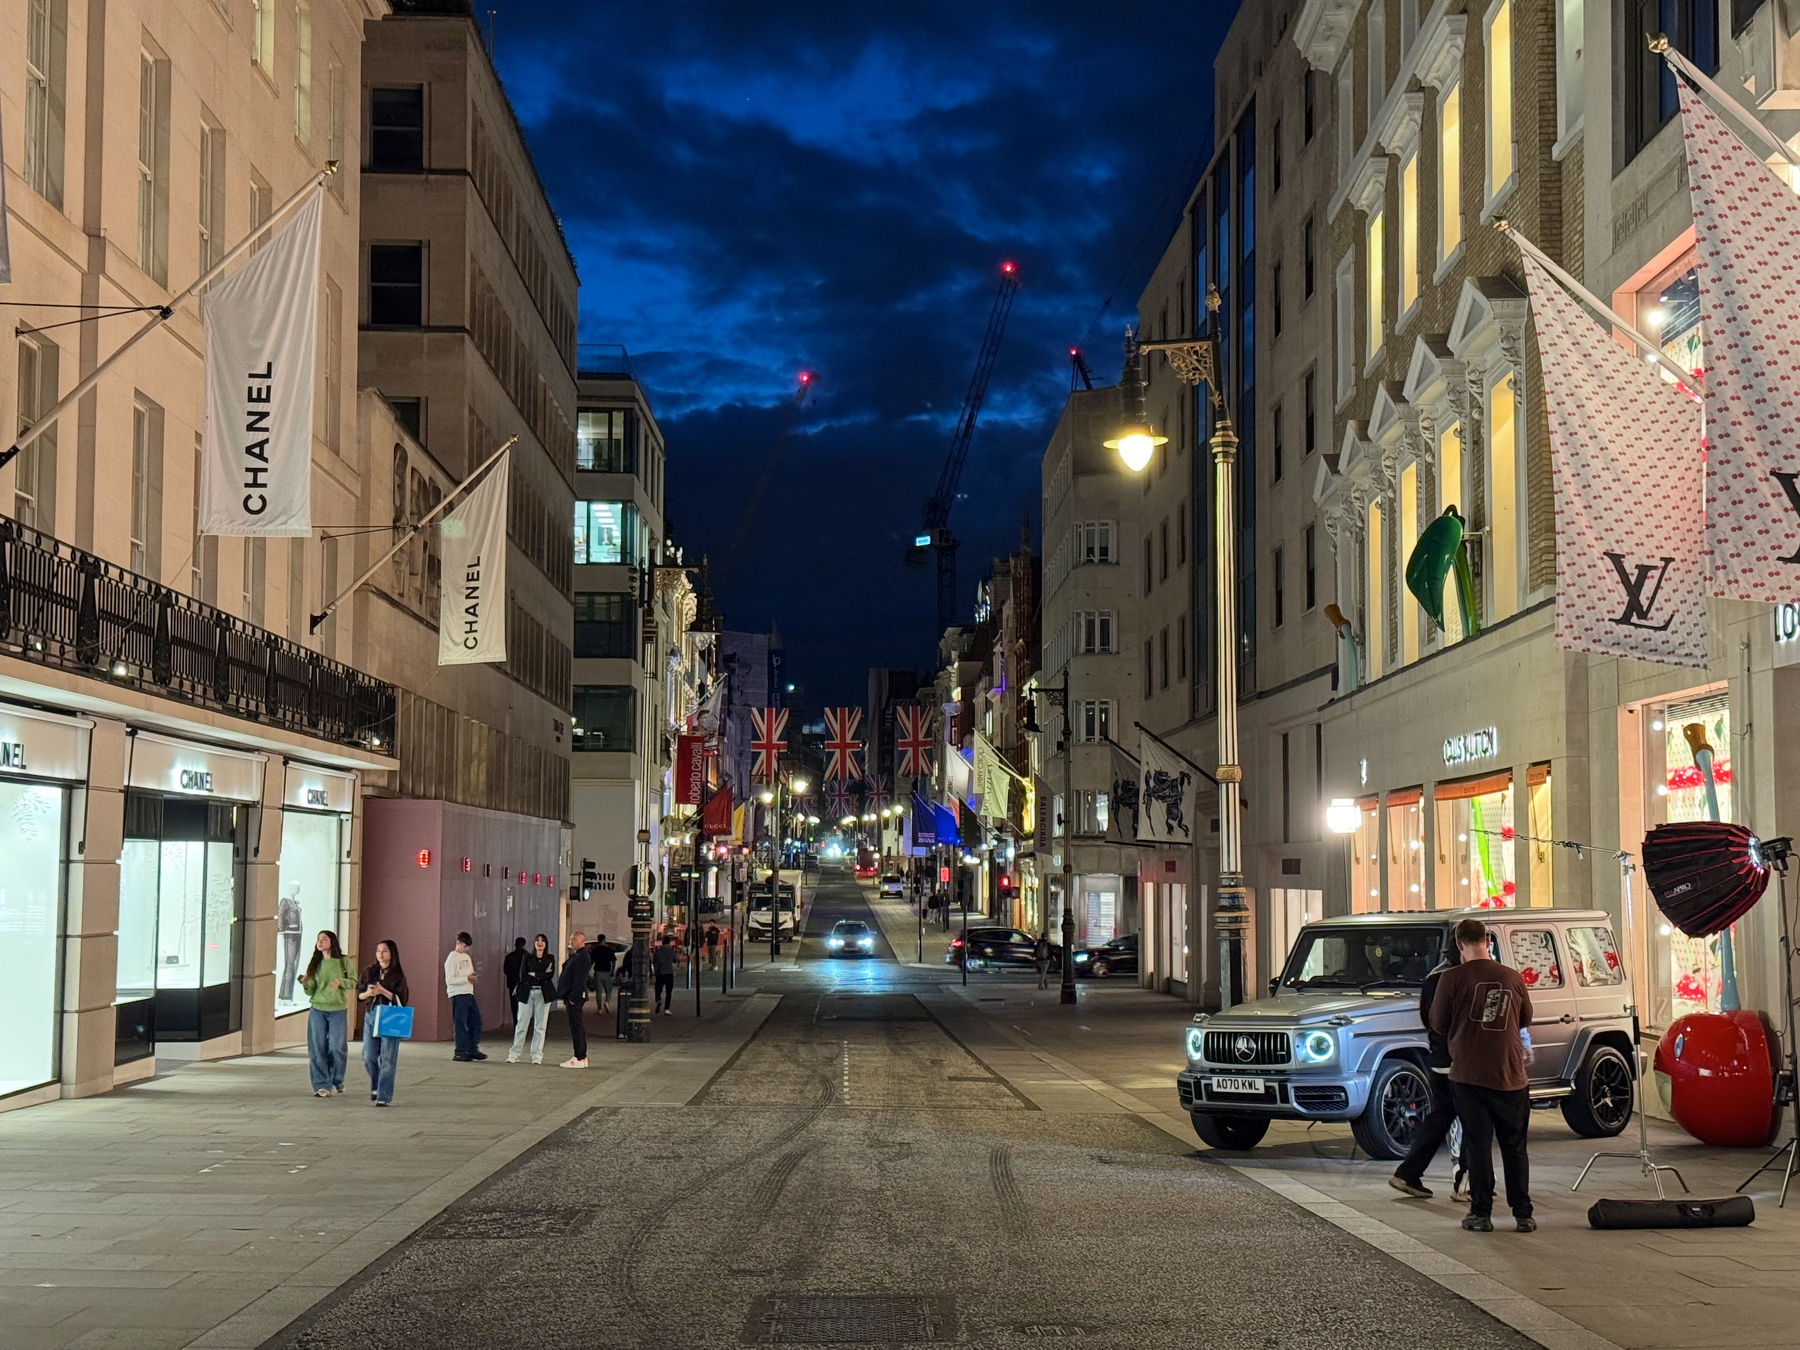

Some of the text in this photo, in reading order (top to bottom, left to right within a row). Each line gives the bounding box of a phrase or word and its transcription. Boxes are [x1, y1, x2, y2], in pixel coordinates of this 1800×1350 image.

[243, 361, 272, 515] CHANEL
[463, 556, 480, 650] CHANEL
[1774, 603, 1800, 642] LO
[0, 741, 27, 769] NEL
[180, 769, 213, 793] CHANEL
[688, 742, 703, 804] roberto cavalli
[307, 788, 328, 806] CHANEL
[1242, 1079, 1259, 1091] KWL
